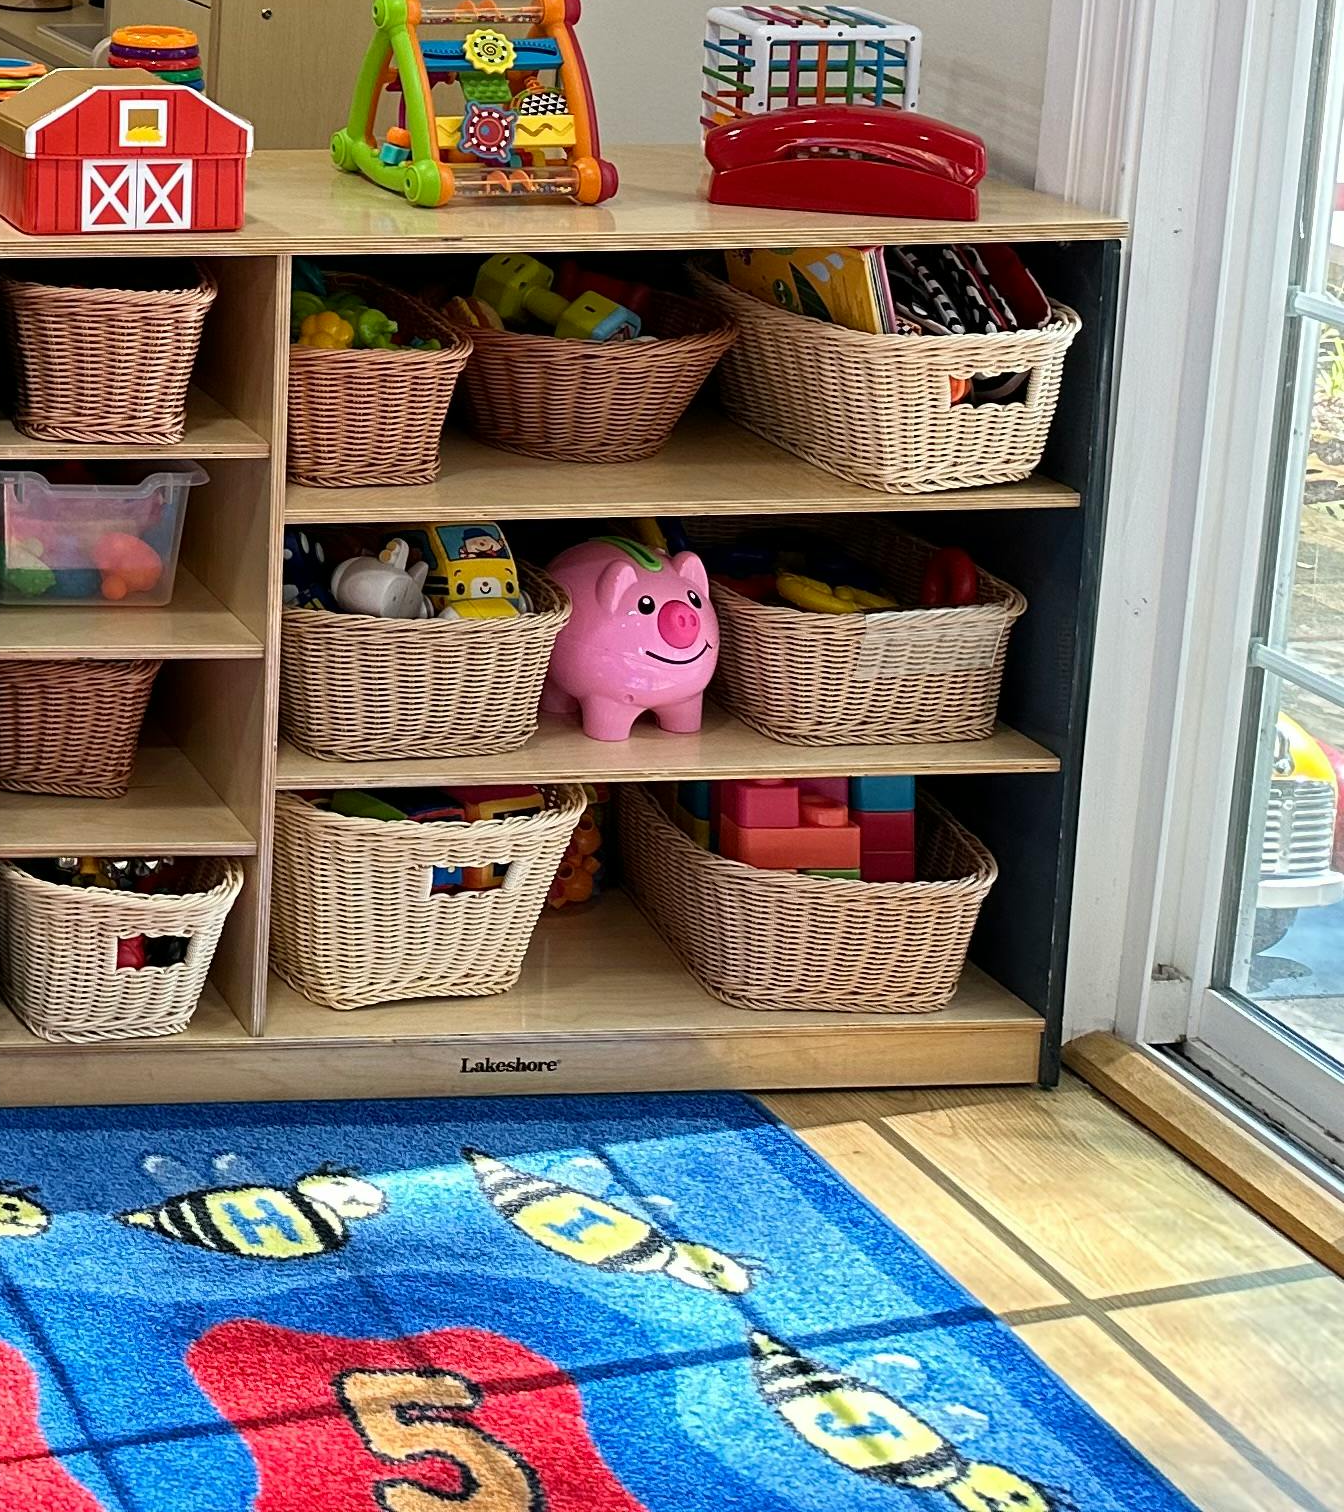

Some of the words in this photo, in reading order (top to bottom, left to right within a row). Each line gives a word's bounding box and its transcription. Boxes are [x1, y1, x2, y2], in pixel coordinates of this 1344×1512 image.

[460, 1057, 558, 1073] Lakeshore
[221, 1200, 298, 1247] H
[334, 1366, 543, 1512] 5
